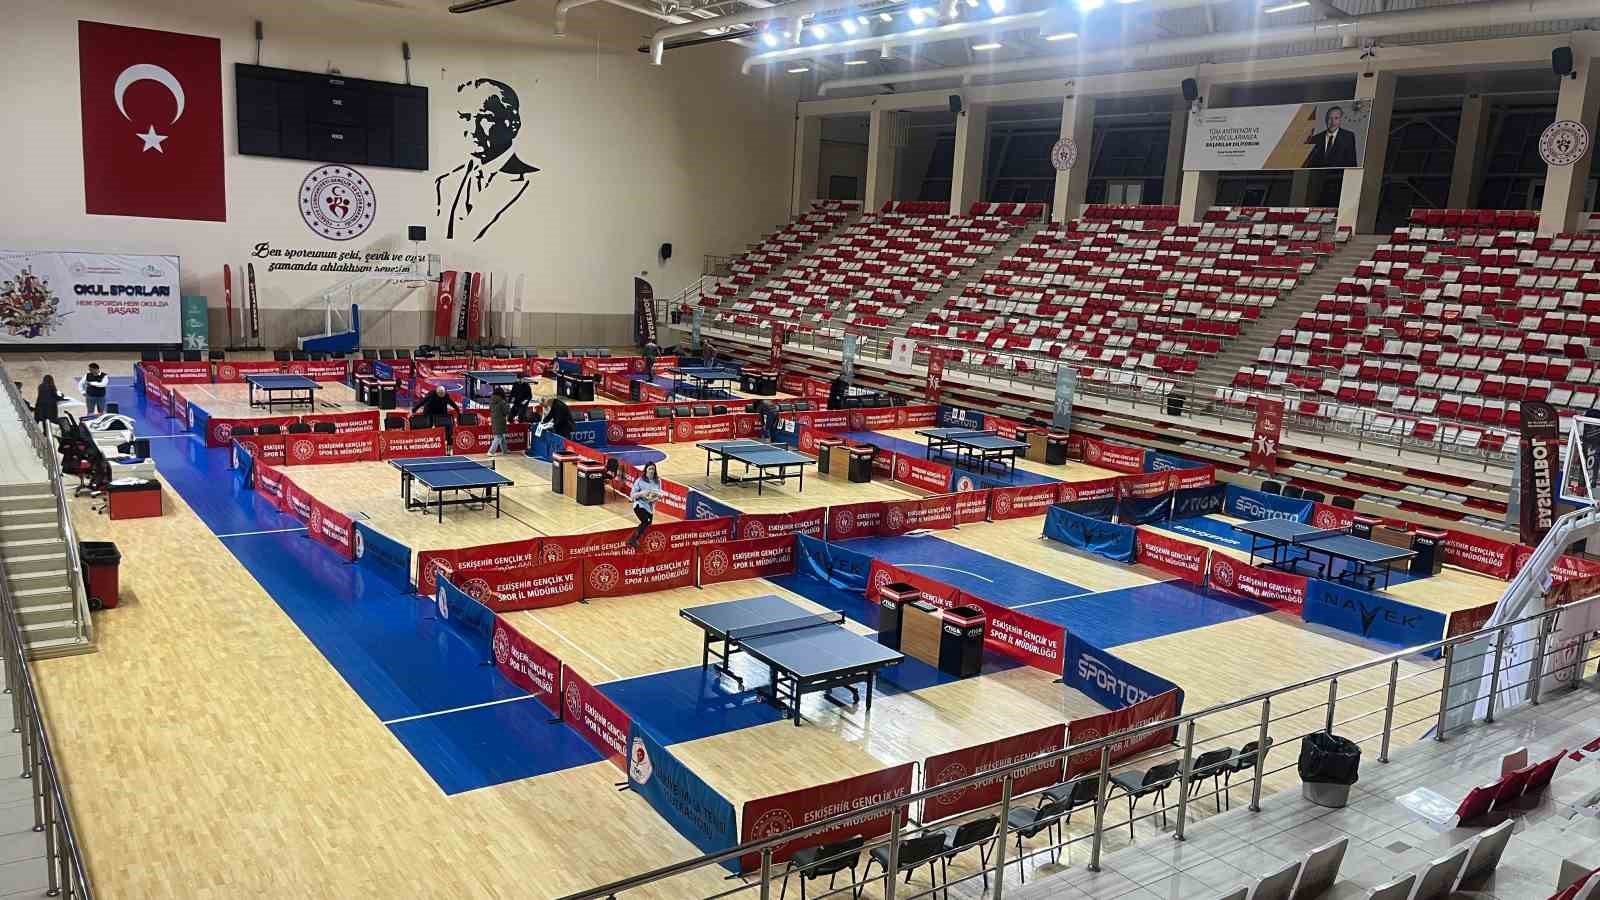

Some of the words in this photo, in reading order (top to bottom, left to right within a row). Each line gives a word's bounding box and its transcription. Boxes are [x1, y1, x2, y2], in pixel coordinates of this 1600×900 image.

[251, 241, 282, 258] Ben
[284, 248, 337, 259] sporcunun
[268, 262, 318, 272] zamanda
[74, 284, 109, 296] OKUL
[732, 561, 749, 570] SPOR
[497, 578, 531, 591] ESKİŞEHİR
[532, 574, 564, 587] GENÇLİK
[565, 573, 574, 581] VE
[624, 577, 642, 585] SPOR
[497, 590, 517, 602] SPOR
[518, 589, 526, 599] İL
[527, 583, 574, 598] MÜDÜRLÜĞÜ
[992, 618, 1022, 636] ESKİŞEHİR
[1023, 630, 1048, 646] GENÇLİK
[1048, 639, 1057, 648] VE
[990, 629, 1008, 641] SPOR
[1008, 635, 1014, 644] İL
[1014, 637, 1057, 659] MÜDÜRLÜĞÜ
[1078, 658, 1154, 704] SPORTOT
[803, 799, 850, 823] ESKİŞEHİR
